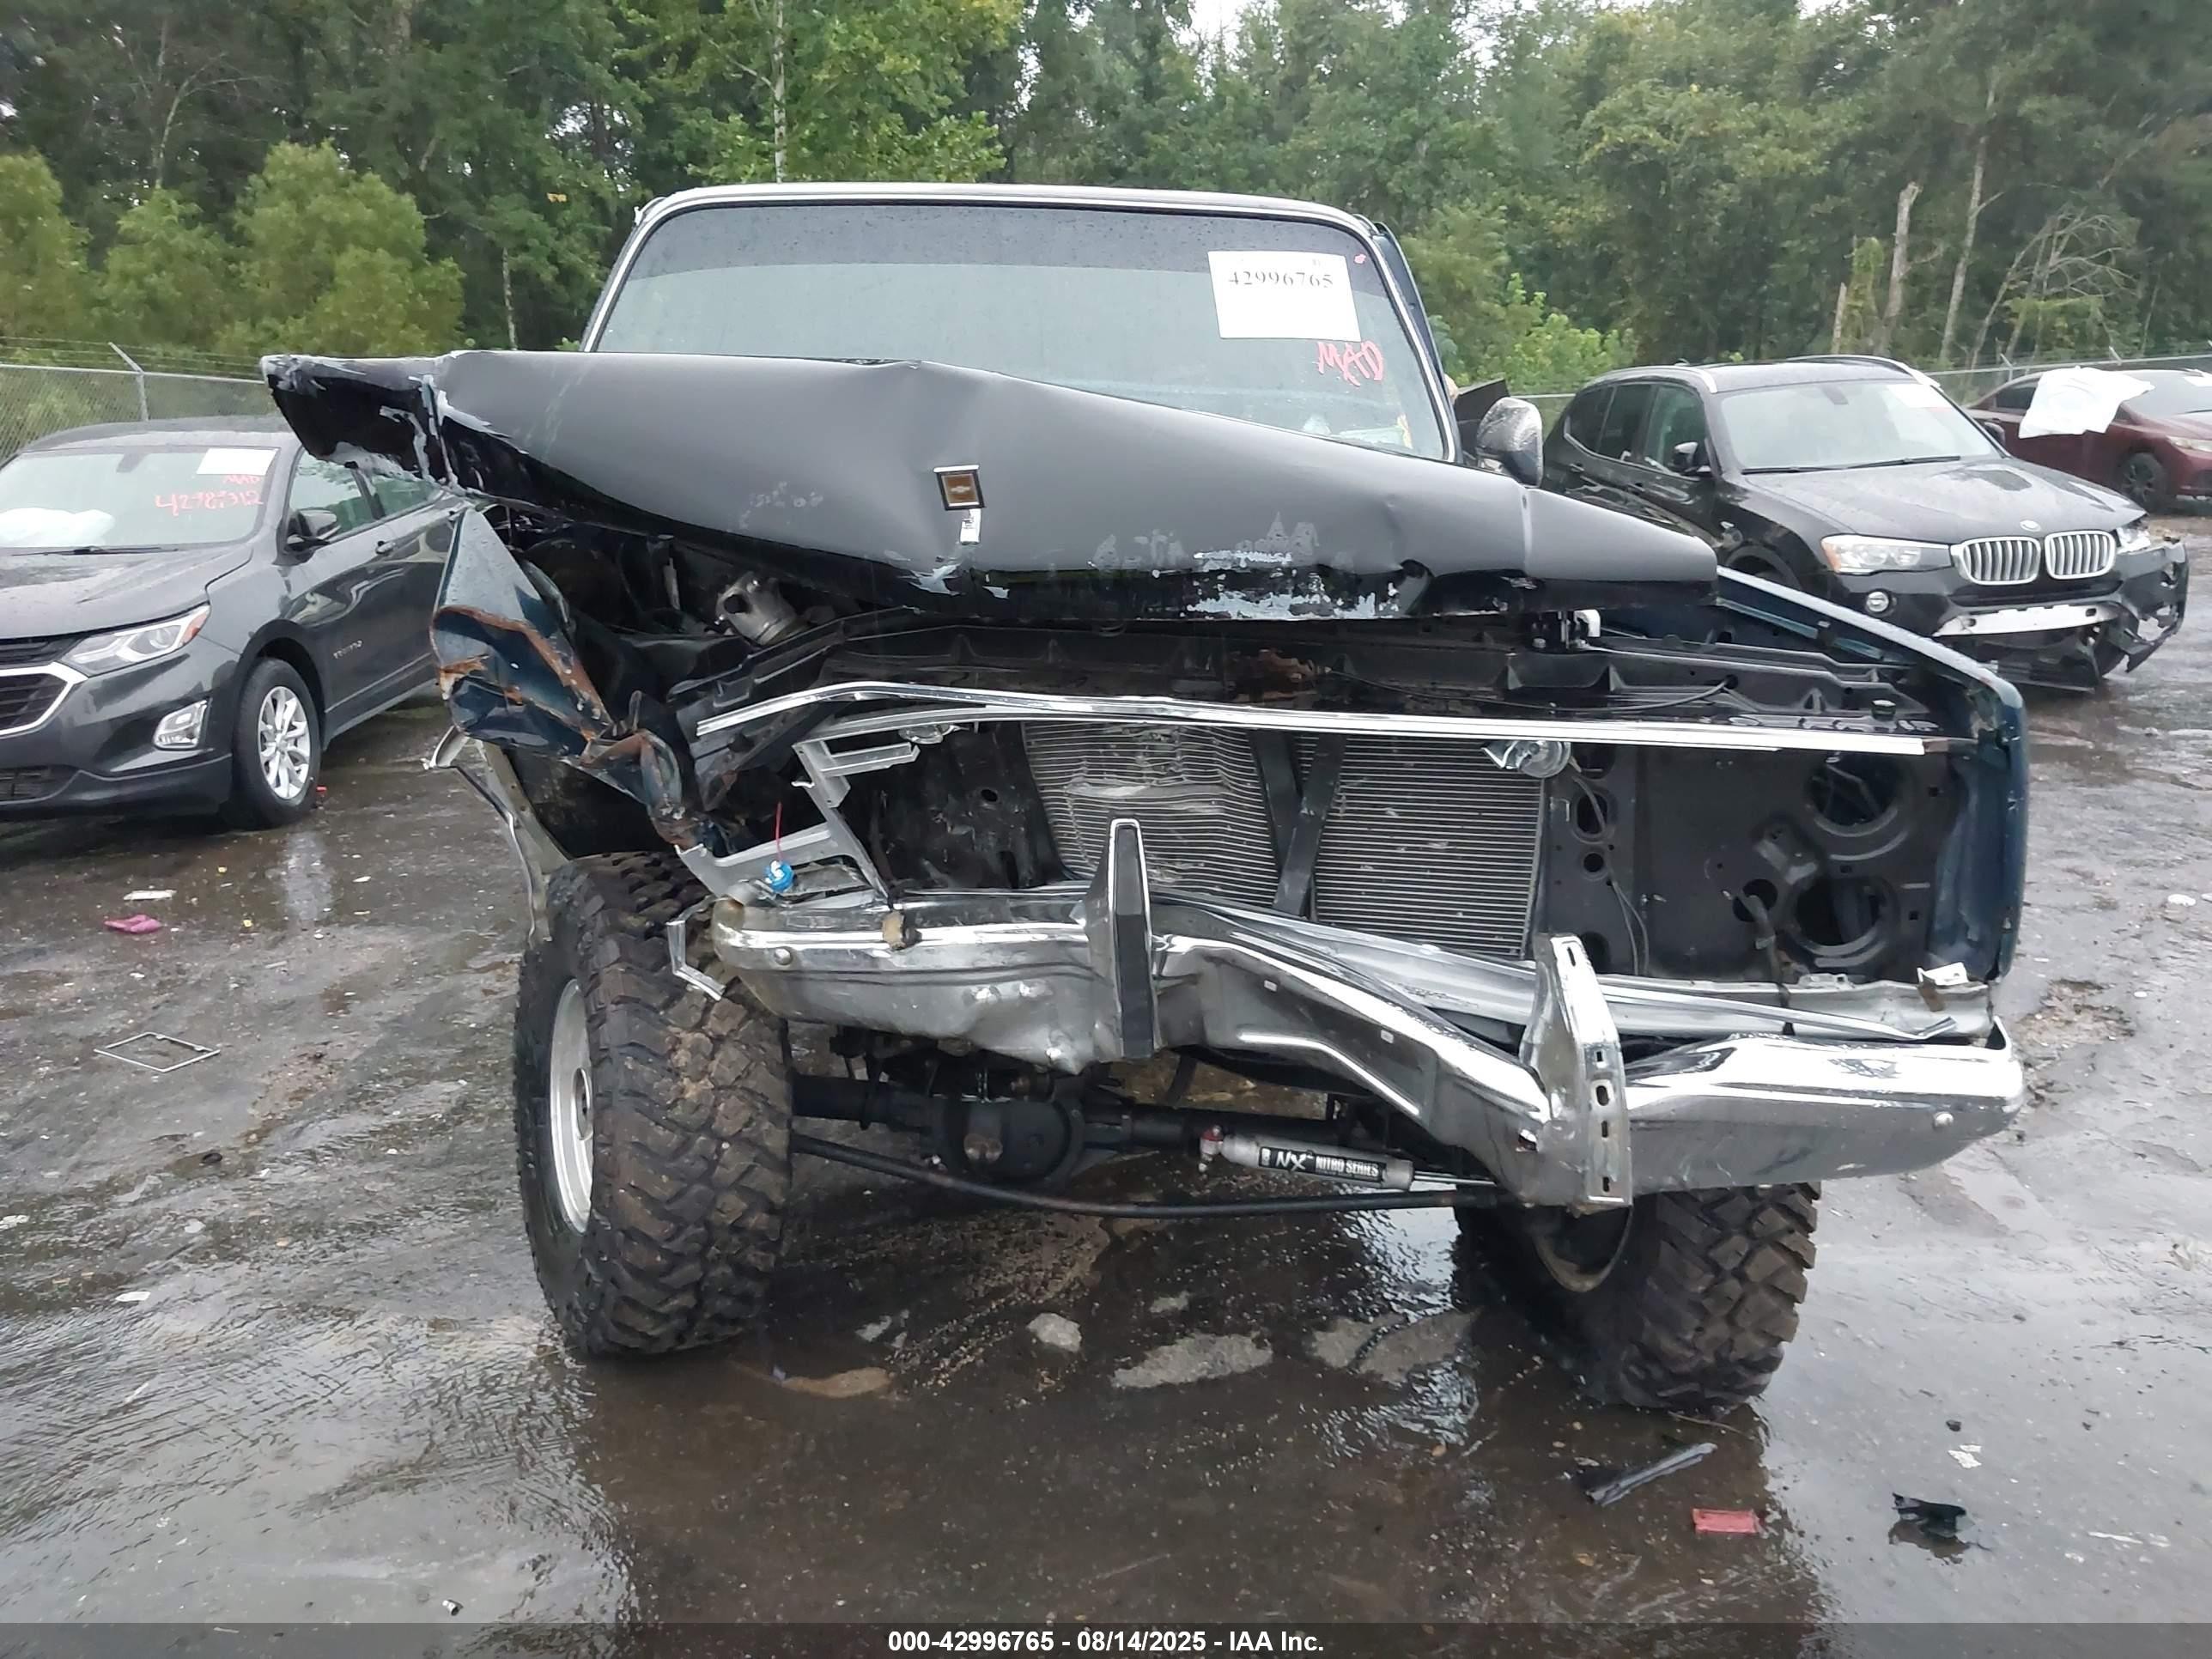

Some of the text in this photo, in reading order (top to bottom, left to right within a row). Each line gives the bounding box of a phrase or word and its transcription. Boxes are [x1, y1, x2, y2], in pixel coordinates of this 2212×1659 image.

[1228, 270, 1334, 289] 42996765
[1316, 1155, 1345, 1172] NITRO
[1346, 1159, 1379, 1177] SERIES
